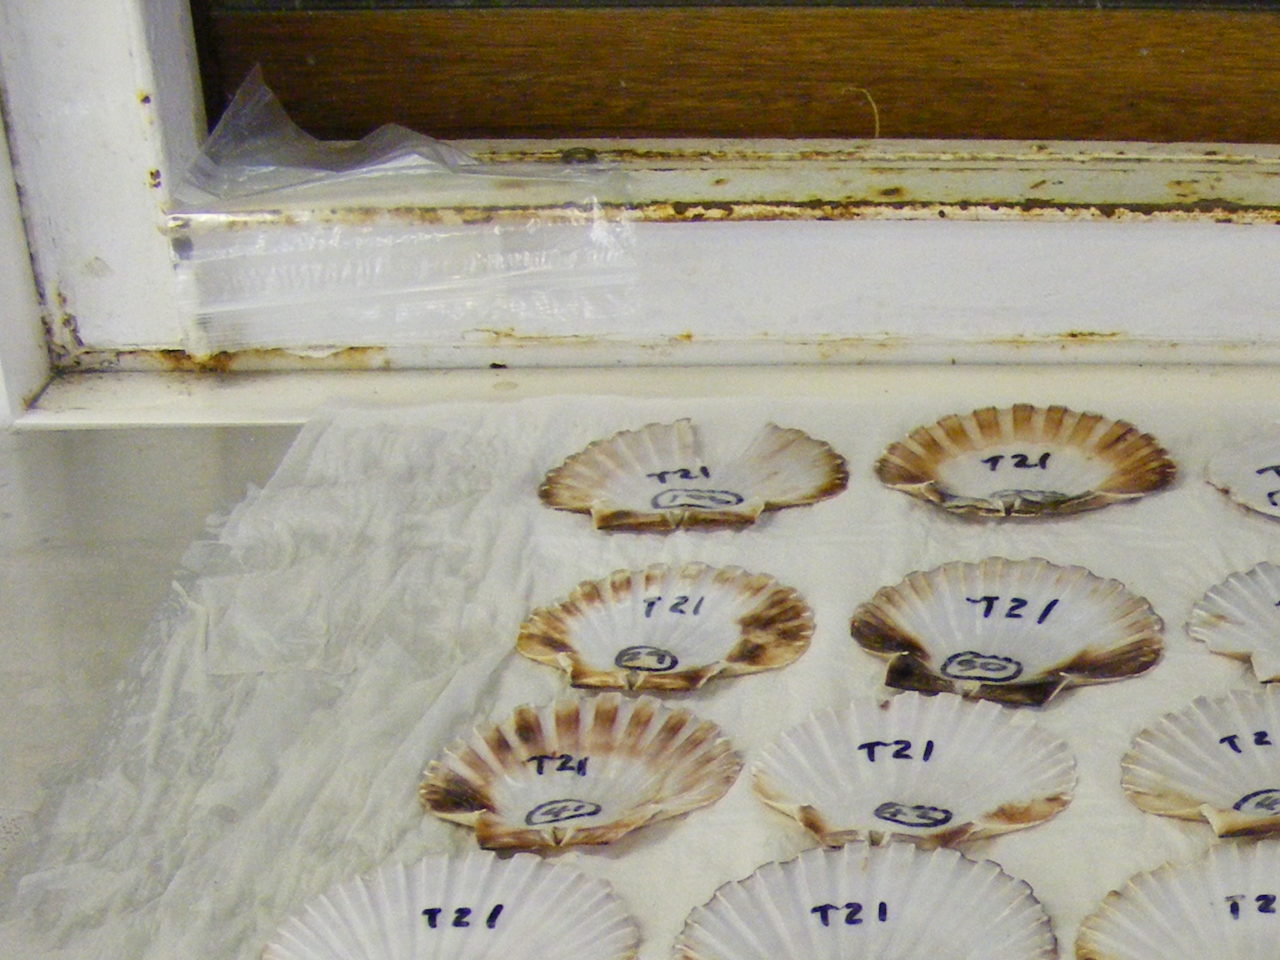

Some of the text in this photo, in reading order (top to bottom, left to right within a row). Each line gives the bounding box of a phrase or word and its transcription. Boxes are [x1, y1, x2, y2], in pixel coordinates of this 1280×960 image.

[980, 452, 1051, 471] T21
[646, 465, 711, 484] T21
[642, 595, 705, 618] T21
[966, 595, 1060, 625] T21
[858, 739, 935, 762] T21
[526, 753, 590, 777] T21
[421, 903, 504, 929] T21
[810, 900, 888, 927] T21
